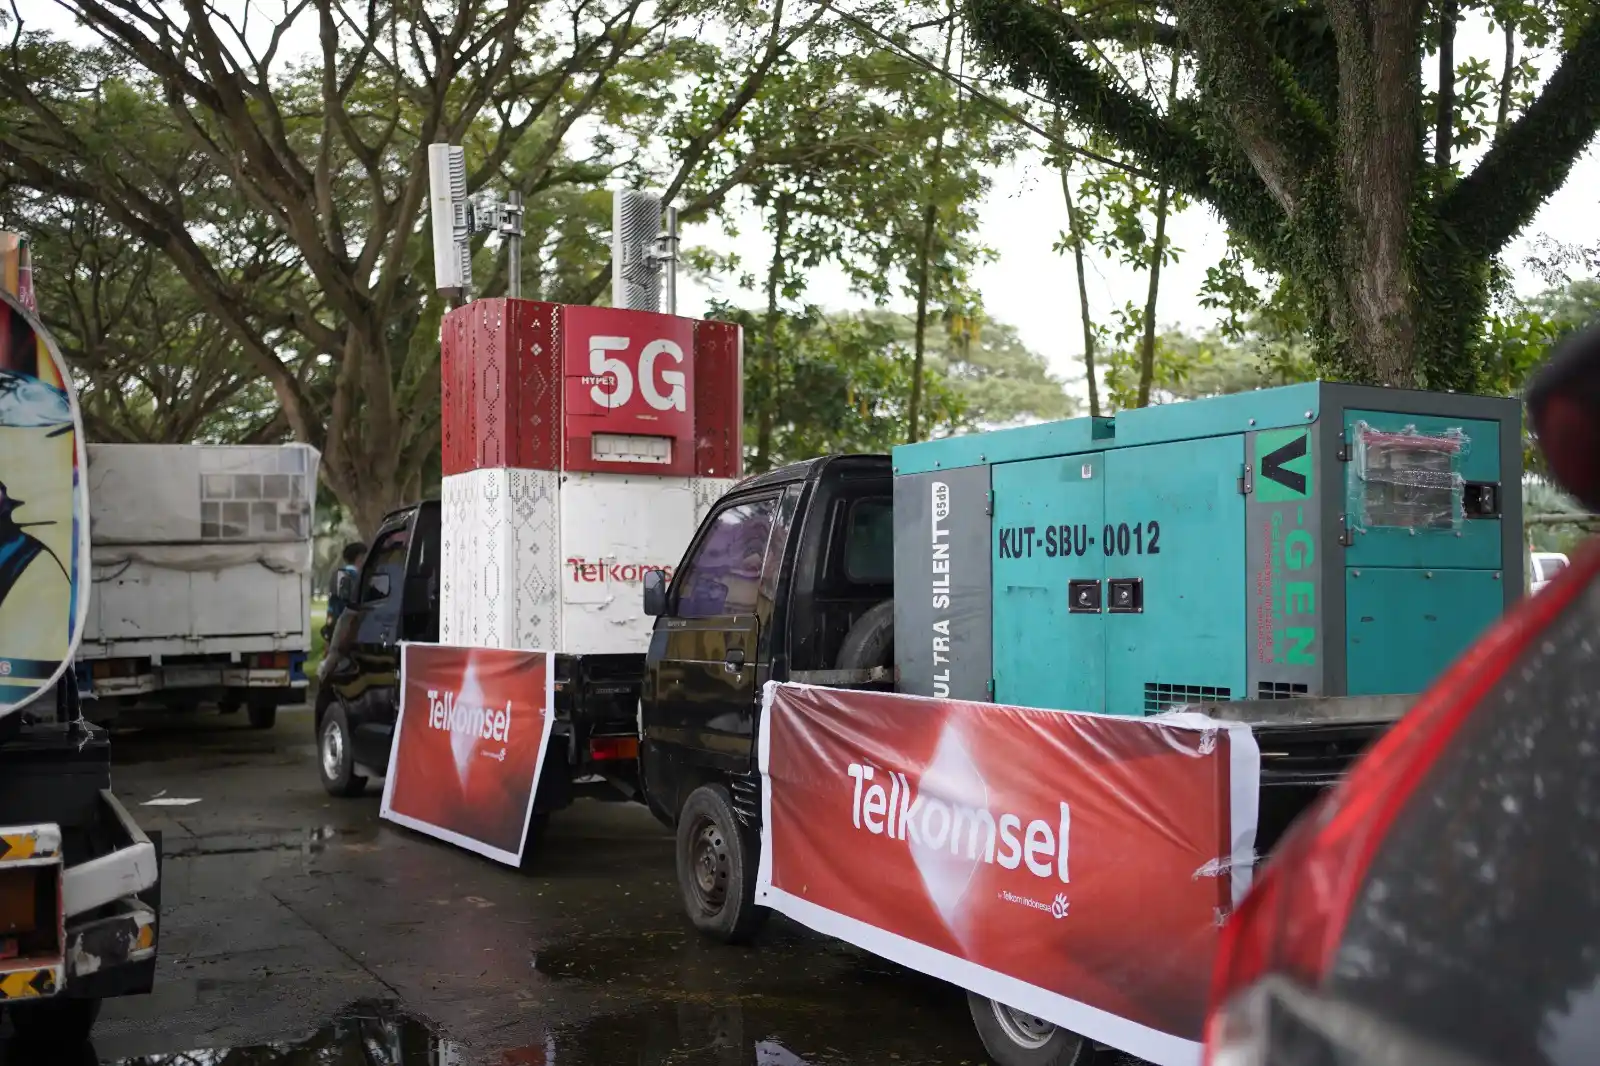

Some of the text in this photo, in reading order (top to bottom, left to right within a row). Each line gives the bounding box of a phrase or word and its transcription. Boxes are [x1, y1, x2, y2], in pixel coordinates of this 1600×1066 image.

[581, 376, 615, 386] HYPER
[587, 335, 686, 412] 5G
[567, 558, 675, 583] Telkoms
[932, 485, 950, 698] ULTRA SILENT 65db
[427, 690, 512, 743] Telkomsel
[847, 763, 1071, 884] Telkomsel
[1003, 890, 1022, 904] Telkom
